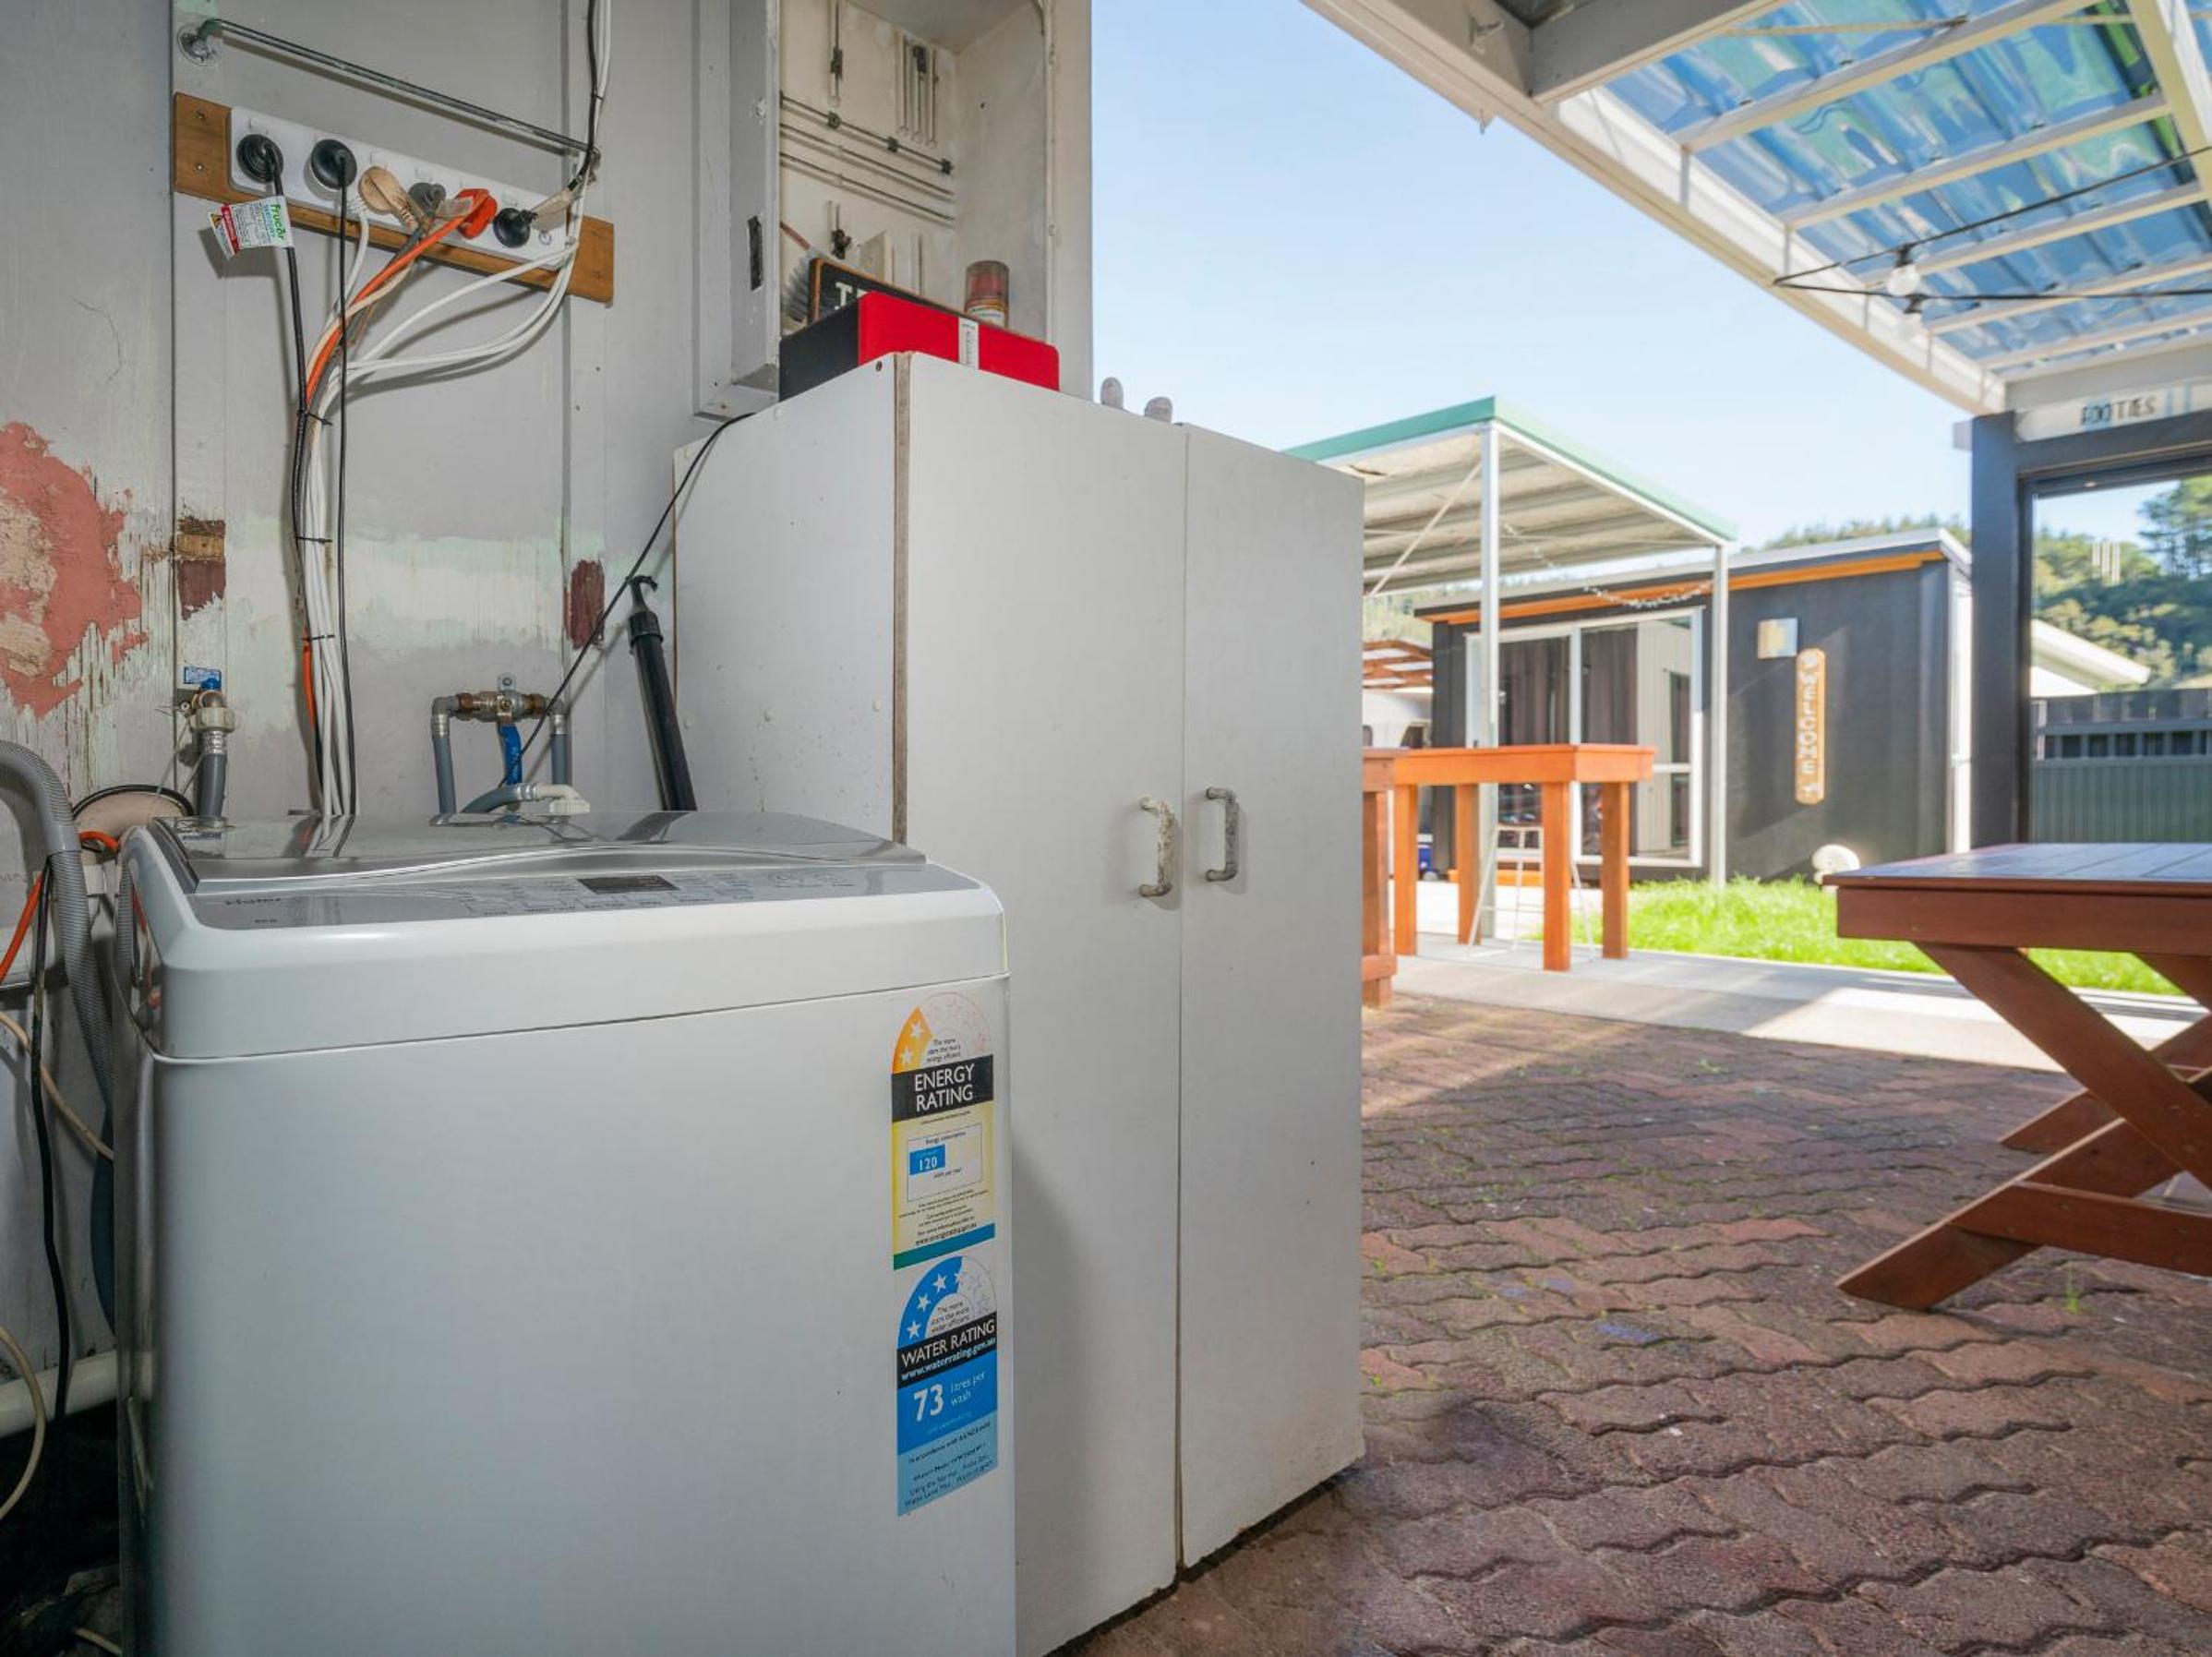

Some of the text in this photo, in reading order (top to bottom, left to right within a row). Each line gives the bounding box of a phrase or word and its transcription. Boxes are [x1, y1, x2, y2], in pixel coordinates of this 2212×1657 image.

[915, 1063, 975, 1092] ENERGY
[916, 1084, 973, 1112] RATING
[920, 1156, 937, 1171] 120
[901, 1319, 995, 1367] WATER RATING
[914, 1383, 944, 1422] 73
